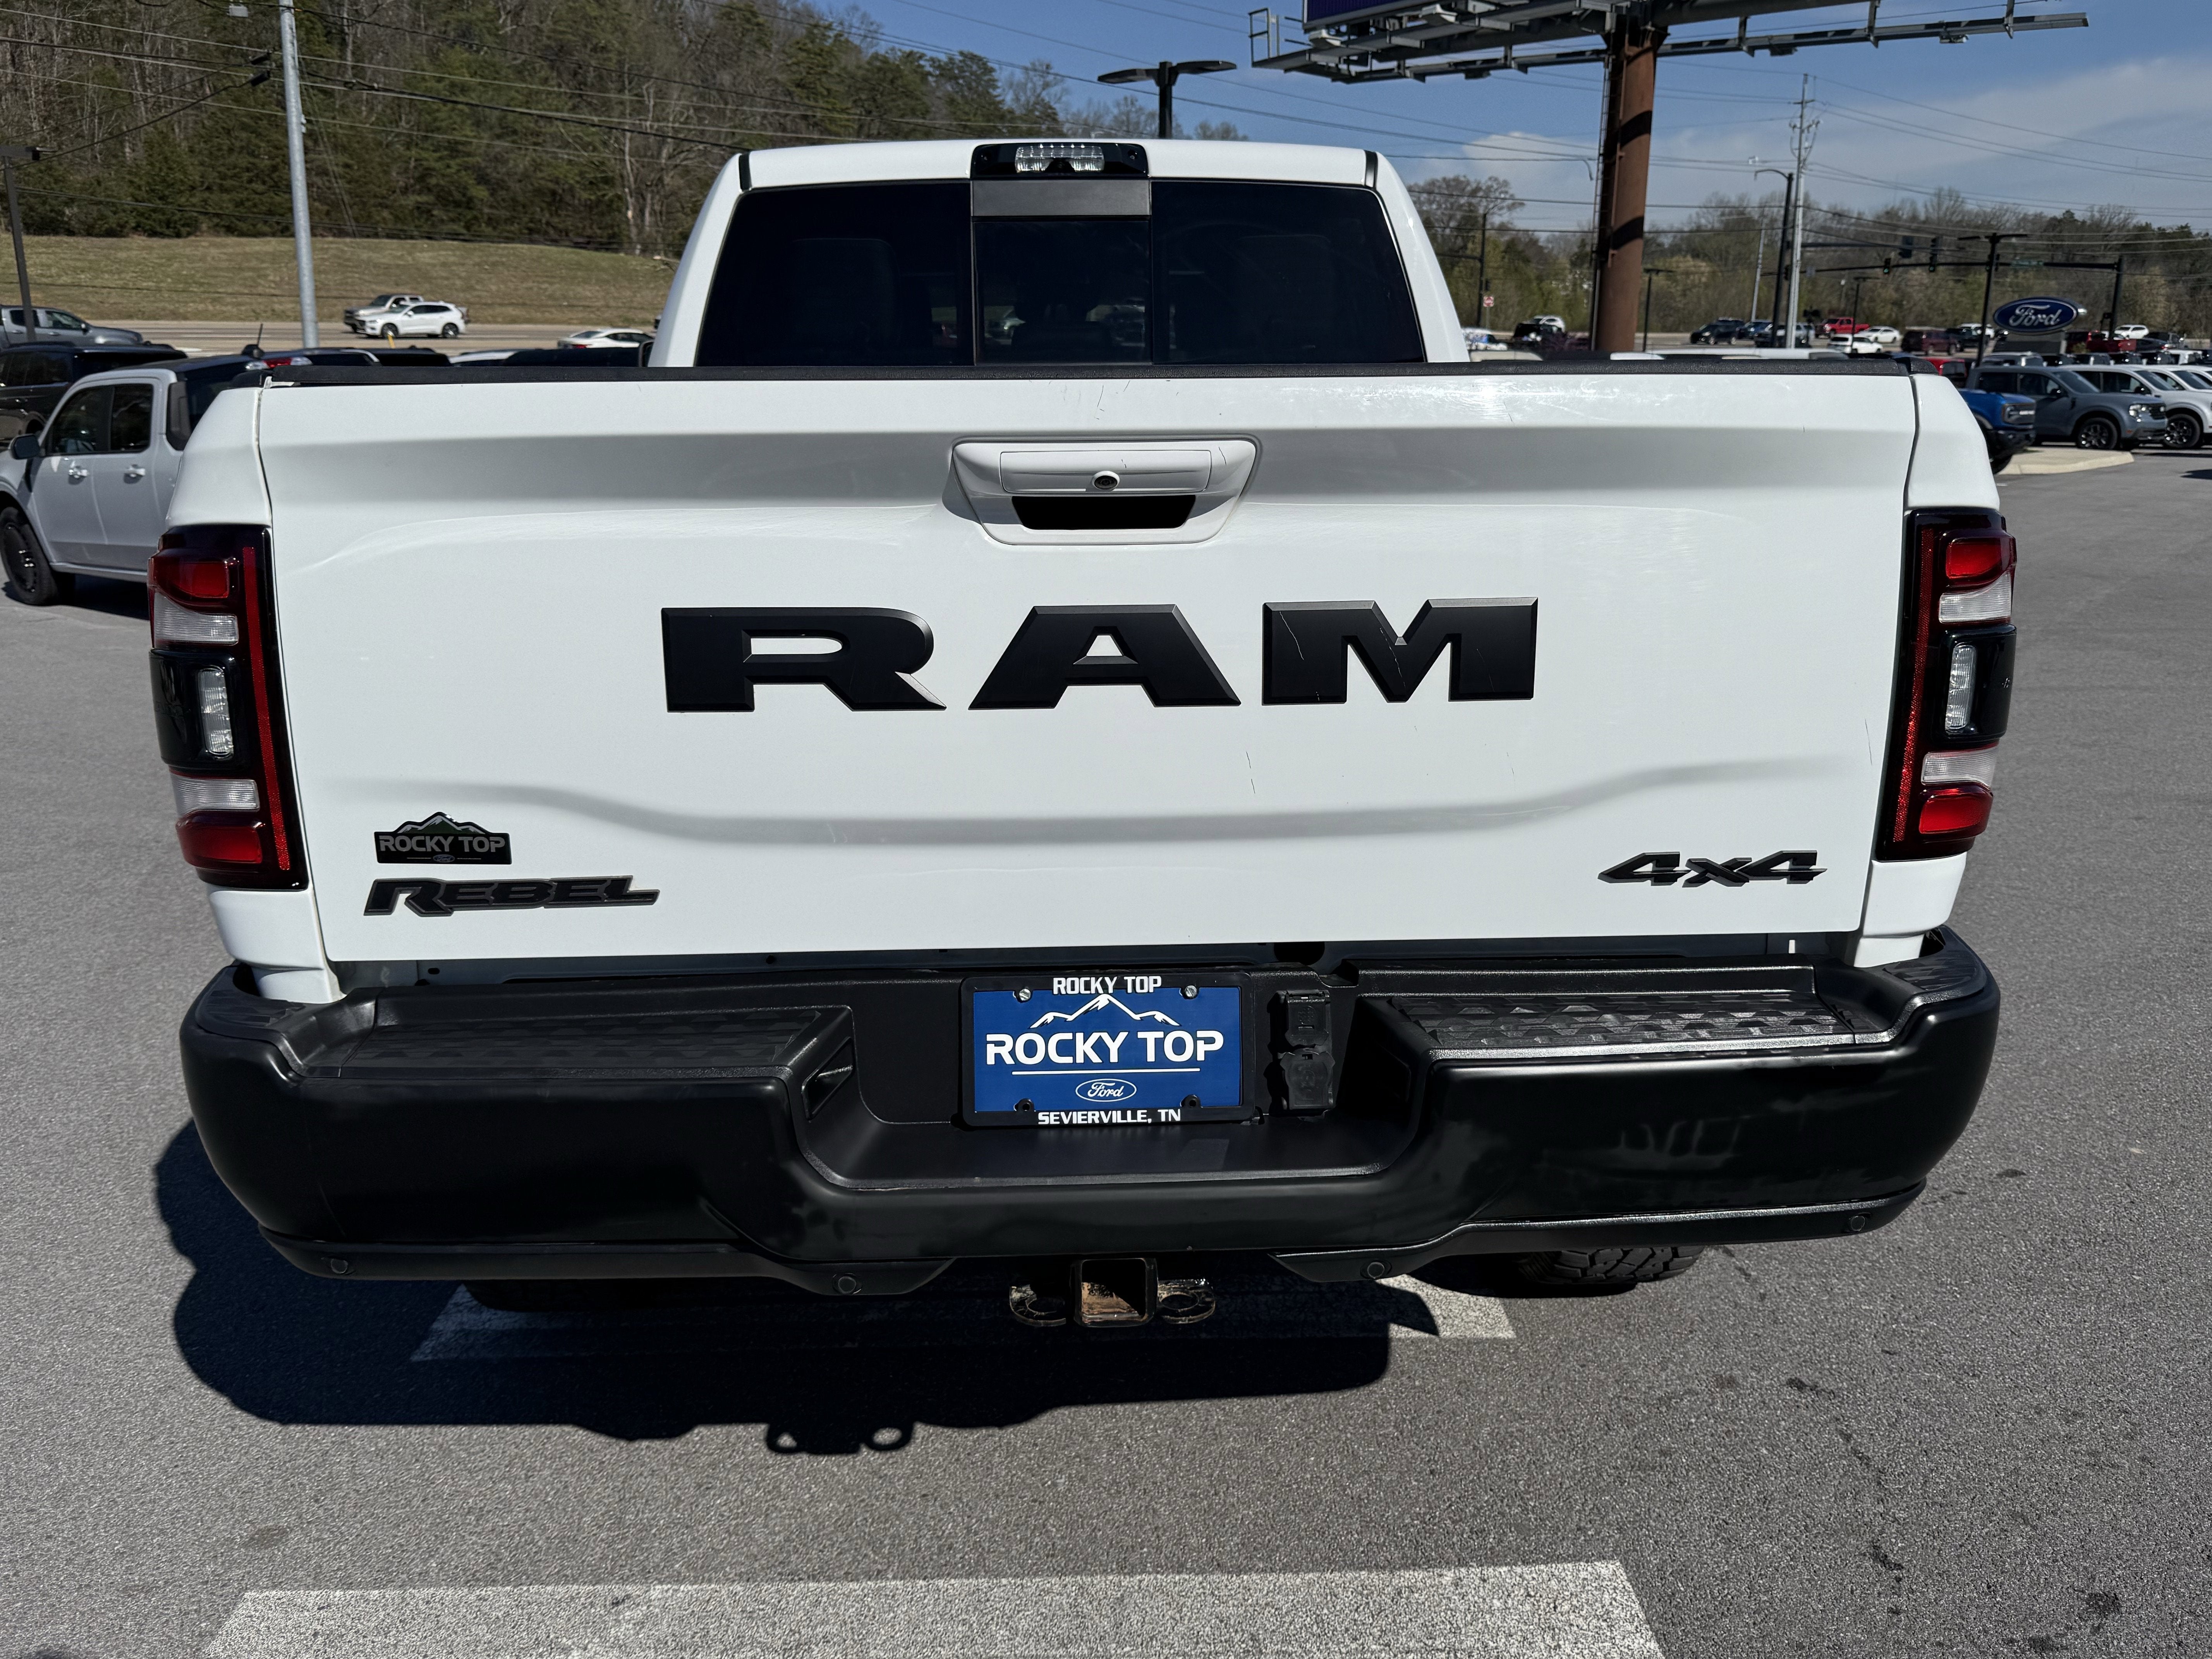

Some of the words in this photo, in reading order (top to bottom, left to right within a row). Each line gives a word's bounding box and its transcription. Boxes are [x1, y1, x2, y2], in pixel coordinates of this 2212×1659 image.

[2009, 304, 2062, 326] Ford
[661, 597, 1538, 713] RAM
[379, 835, 454, 852] ROCKY
[459, 835, 505, 852] TOP
[1597, 850, 1827, 888] 4x4
[363, 875, 660, 917] REBEL
[1053, 977, 1117, 995] ROCKY
[1123, 975, 1162, 993] TOP
[986, 1031, 1129, 1065] ROCKY
[1137, 1030, 1224, 1062] TOP
[1087, 1082, 1125, 1097] Ford
[1038, 1109, 1152, 1125] SEVIERVILLE,
[1158, 1108, 1181, 1122] TN
